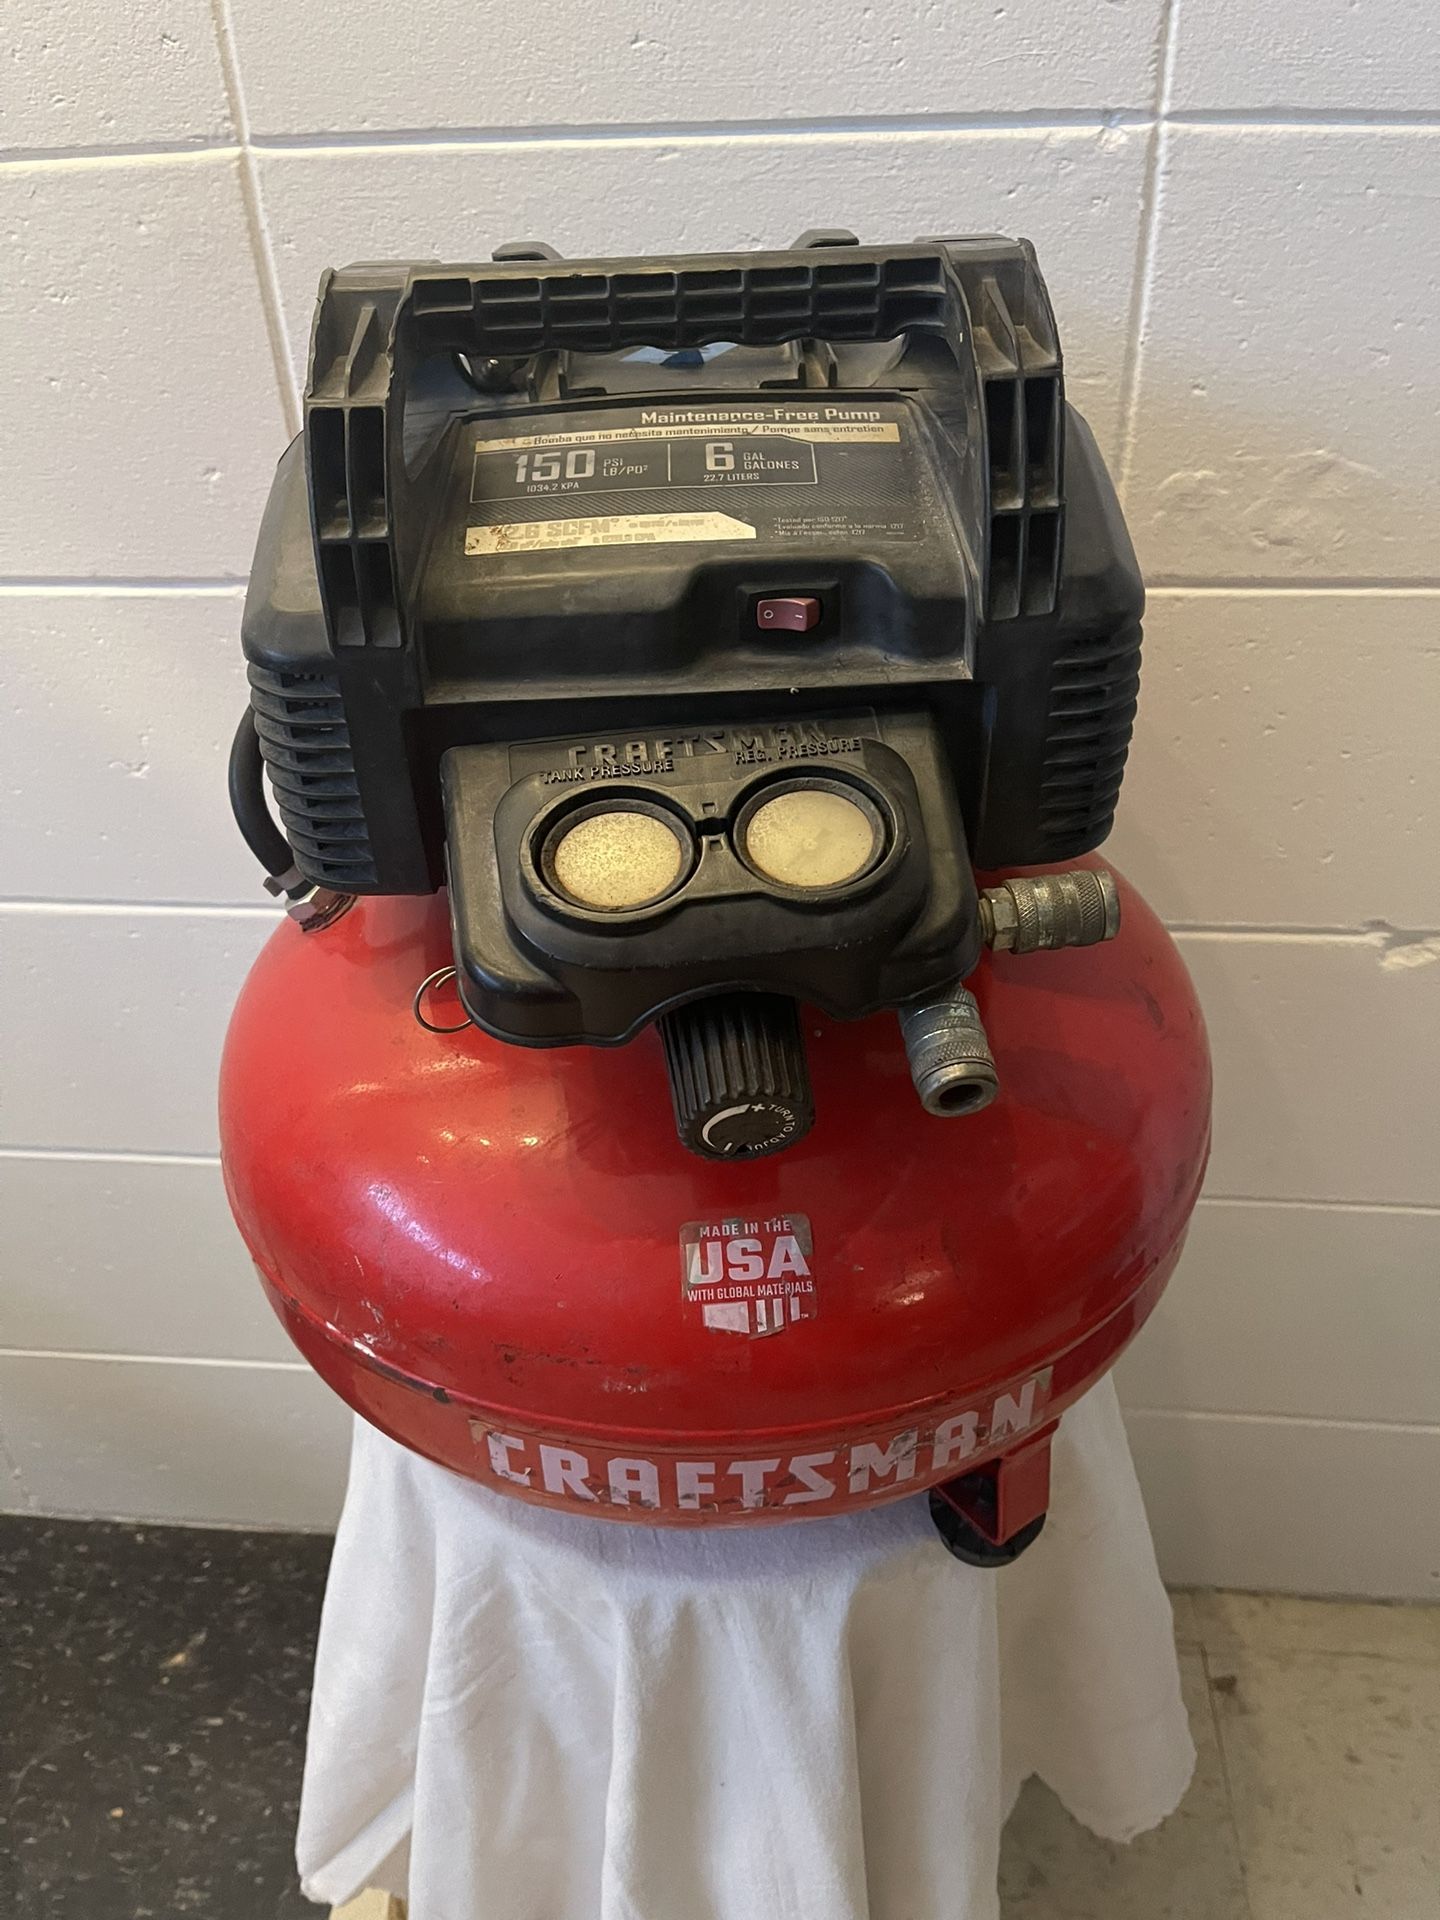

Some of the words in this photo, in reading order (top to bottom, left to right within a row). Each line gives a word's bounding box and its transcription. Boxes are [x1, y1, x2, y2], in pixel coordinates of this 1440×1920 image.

[641, 408, 819, 424] Maintenance-Free
[824, 408, 881, 423] Pump
[533, 435, 572, 445] Bomba
[575, 433, 595, 443] que
[598, 432, 612, 441] no
[665, 426, 748, 435] mantenimiento
[762, 425, 800, 434] Pompe
[832, 425, 884, 433] entretien
[516, 449, 596, 483] 150
[603, 458, 623, 467] PSI
[705, 442, 735, 471] 6
[743, 452, 765, 461] GAL
[744, 460, 799, 470] GALONES
[527, 483, 559, 493] 1034.2
[560, 482, 579, 490] KPA
[703, 474, 724, 482] 22.7
[727, 472, 760, 481] LITERS
[567, 720, 827, 768] CRAFTSMAN
[734, 749, 773, 765] REG.
[775, 736, 863, 760] PRESSURE
[542, 766, 585, 785] TANK
[590, 758, 675, 780] PRESSURE
[700, 1222, 739, 1238] MADE
[744, 1222, 758, 1235] IN
[764, 1219, 791, 1233] THE
[685, 1235, 811, 1285] USA
[687, 1288, 714, 1302] WITH
[717, 1285, 755, 1300] GLOBAL
[757, 1280, 813, 1298] MATERIALS
[486, 1366, 1052, 1509] CRAFTSMAN
